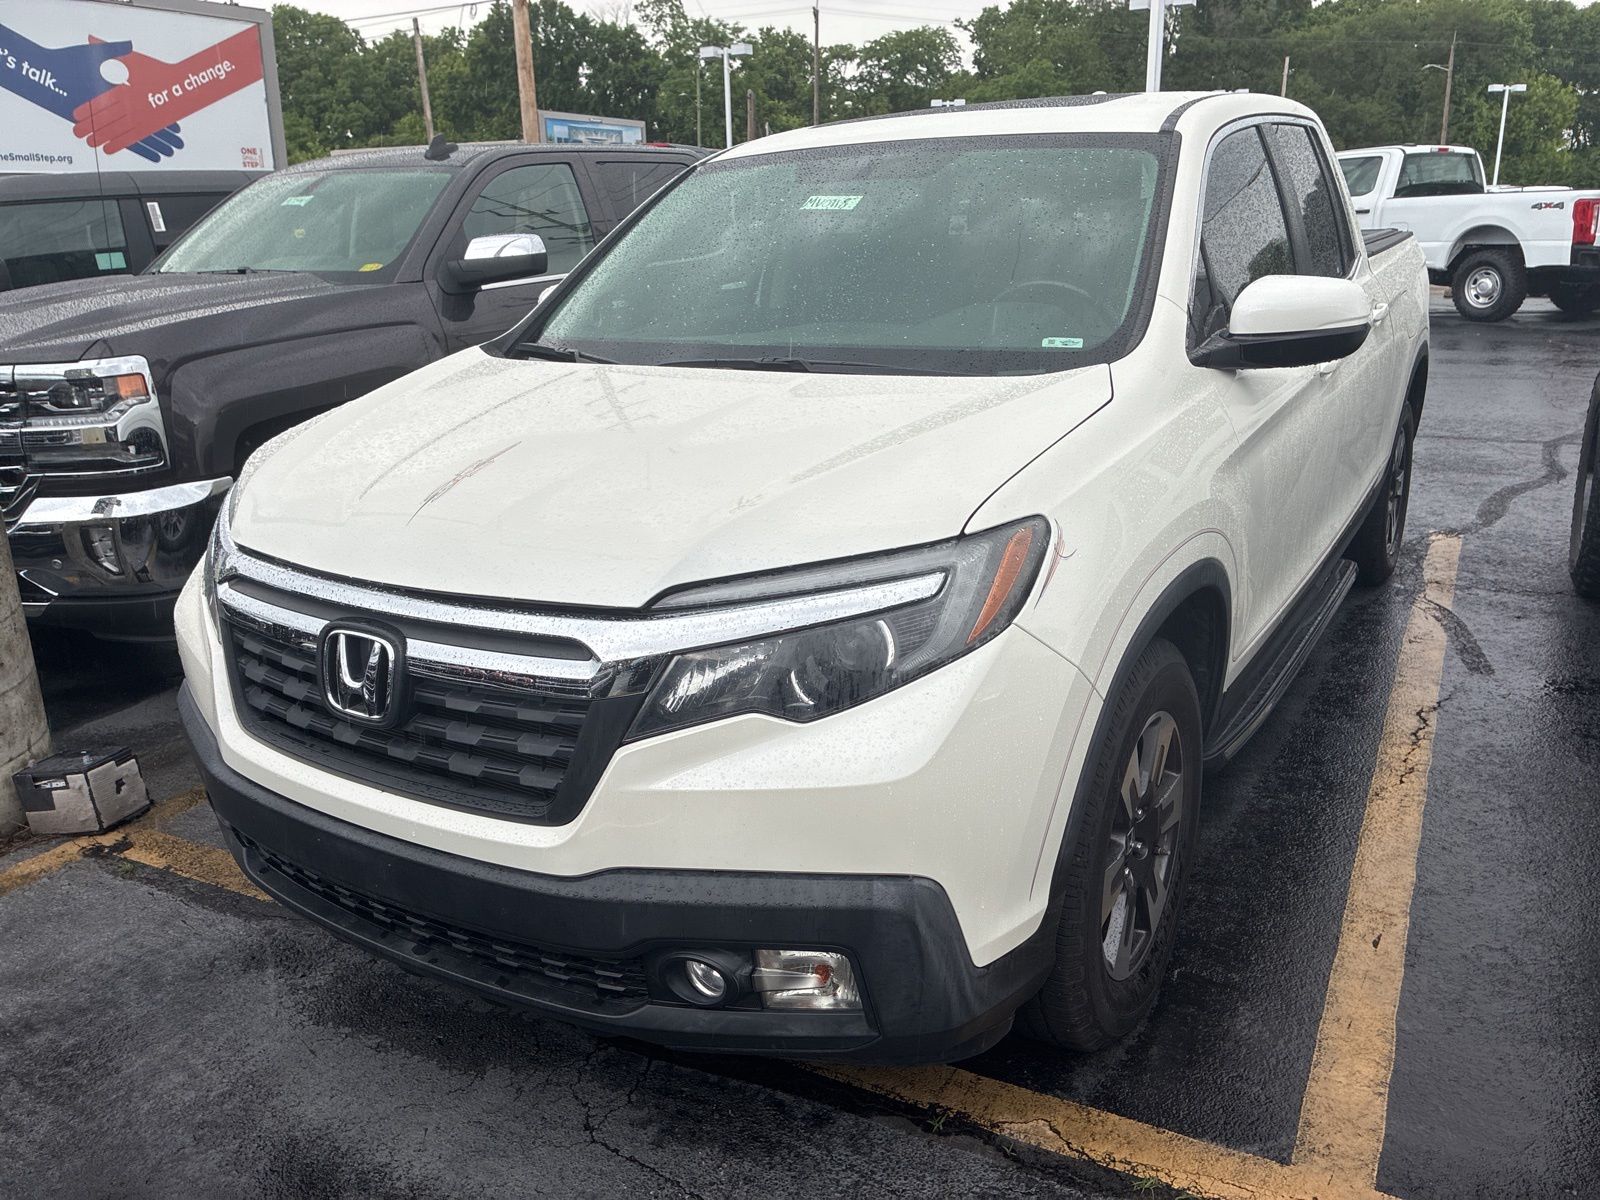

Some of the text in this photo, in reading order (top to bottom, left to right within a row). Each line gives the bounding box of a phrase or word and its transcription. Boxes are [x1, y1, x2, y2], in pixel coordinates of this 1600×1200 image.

[21, 60, 68, 97] talk...
[147, 60, 236, 109] for a change.
[240, 147, 257, 155] ONE
